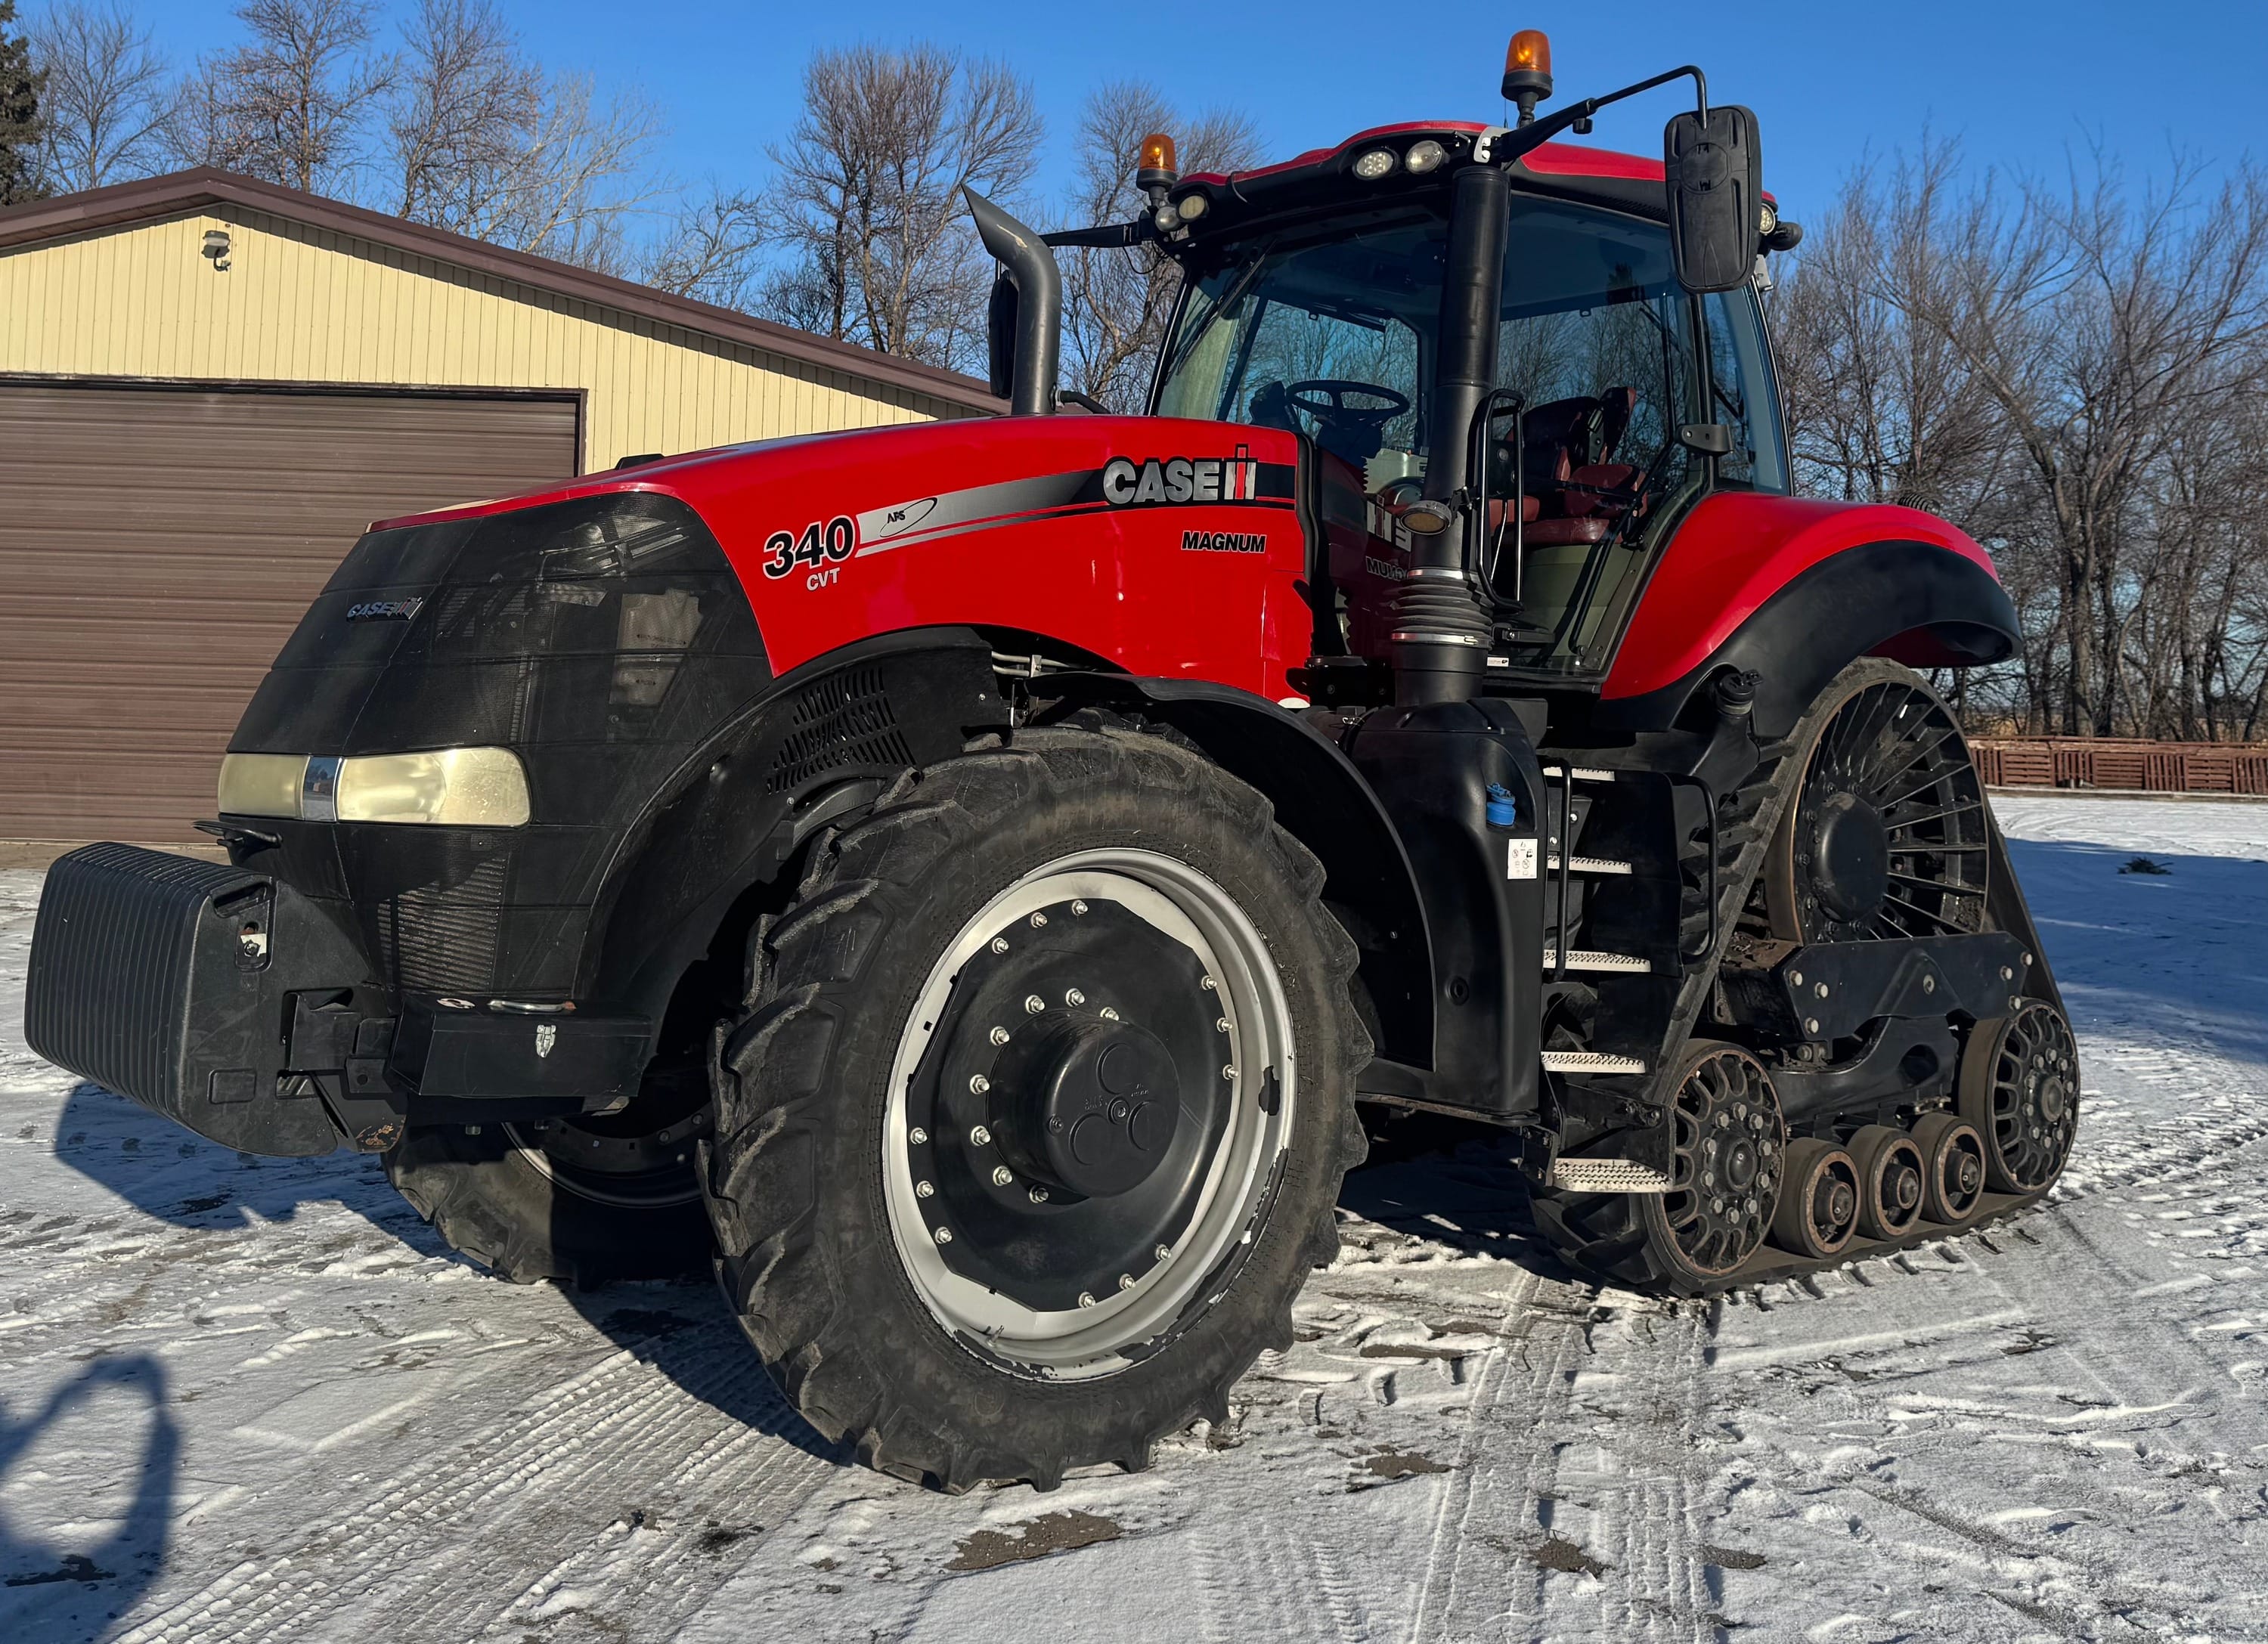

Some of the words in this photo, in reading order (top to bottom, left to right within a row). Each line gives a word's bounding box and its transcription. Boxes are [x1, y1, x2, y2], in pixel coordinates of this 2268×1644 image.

[887, 510, 906, 524] AFS
[762, 515, 856, 580] 340
[1181, 531, 1267, 553] MAGNUM
[806, 567, 841, 591] CVT
